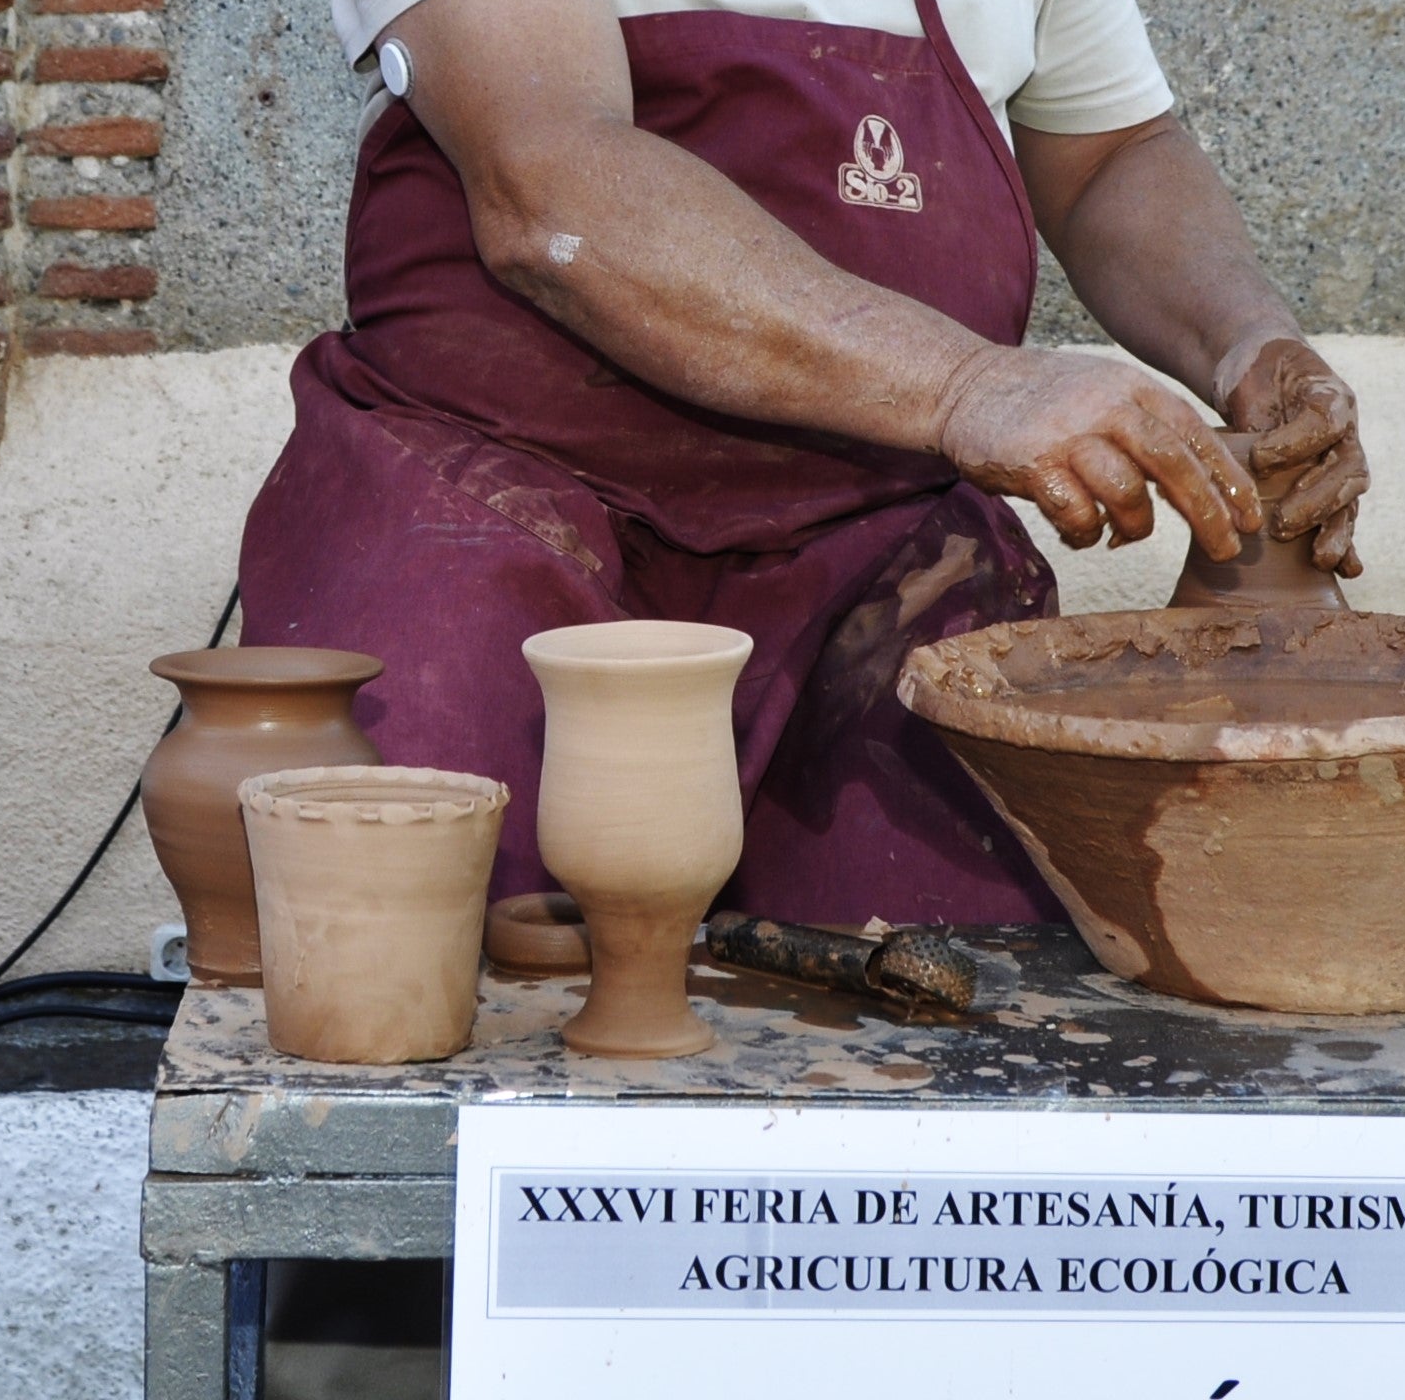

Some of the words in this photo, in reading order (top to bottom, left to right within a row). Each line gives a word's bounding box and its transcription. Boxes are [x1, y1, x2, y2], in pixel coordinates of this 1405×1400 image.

[519, 1186, 675, 1224] XXXVI
[692, 1187, 840, 1225] FERIA
[855, 1188, 918, 1226] DE
[932, 1181, 1226, 1237] ARTESANÍA,
[679, 1254, 1043, 1293] AGRICULTURA
[1057, 1246, 1351, 1296] ECOLÓGICA
